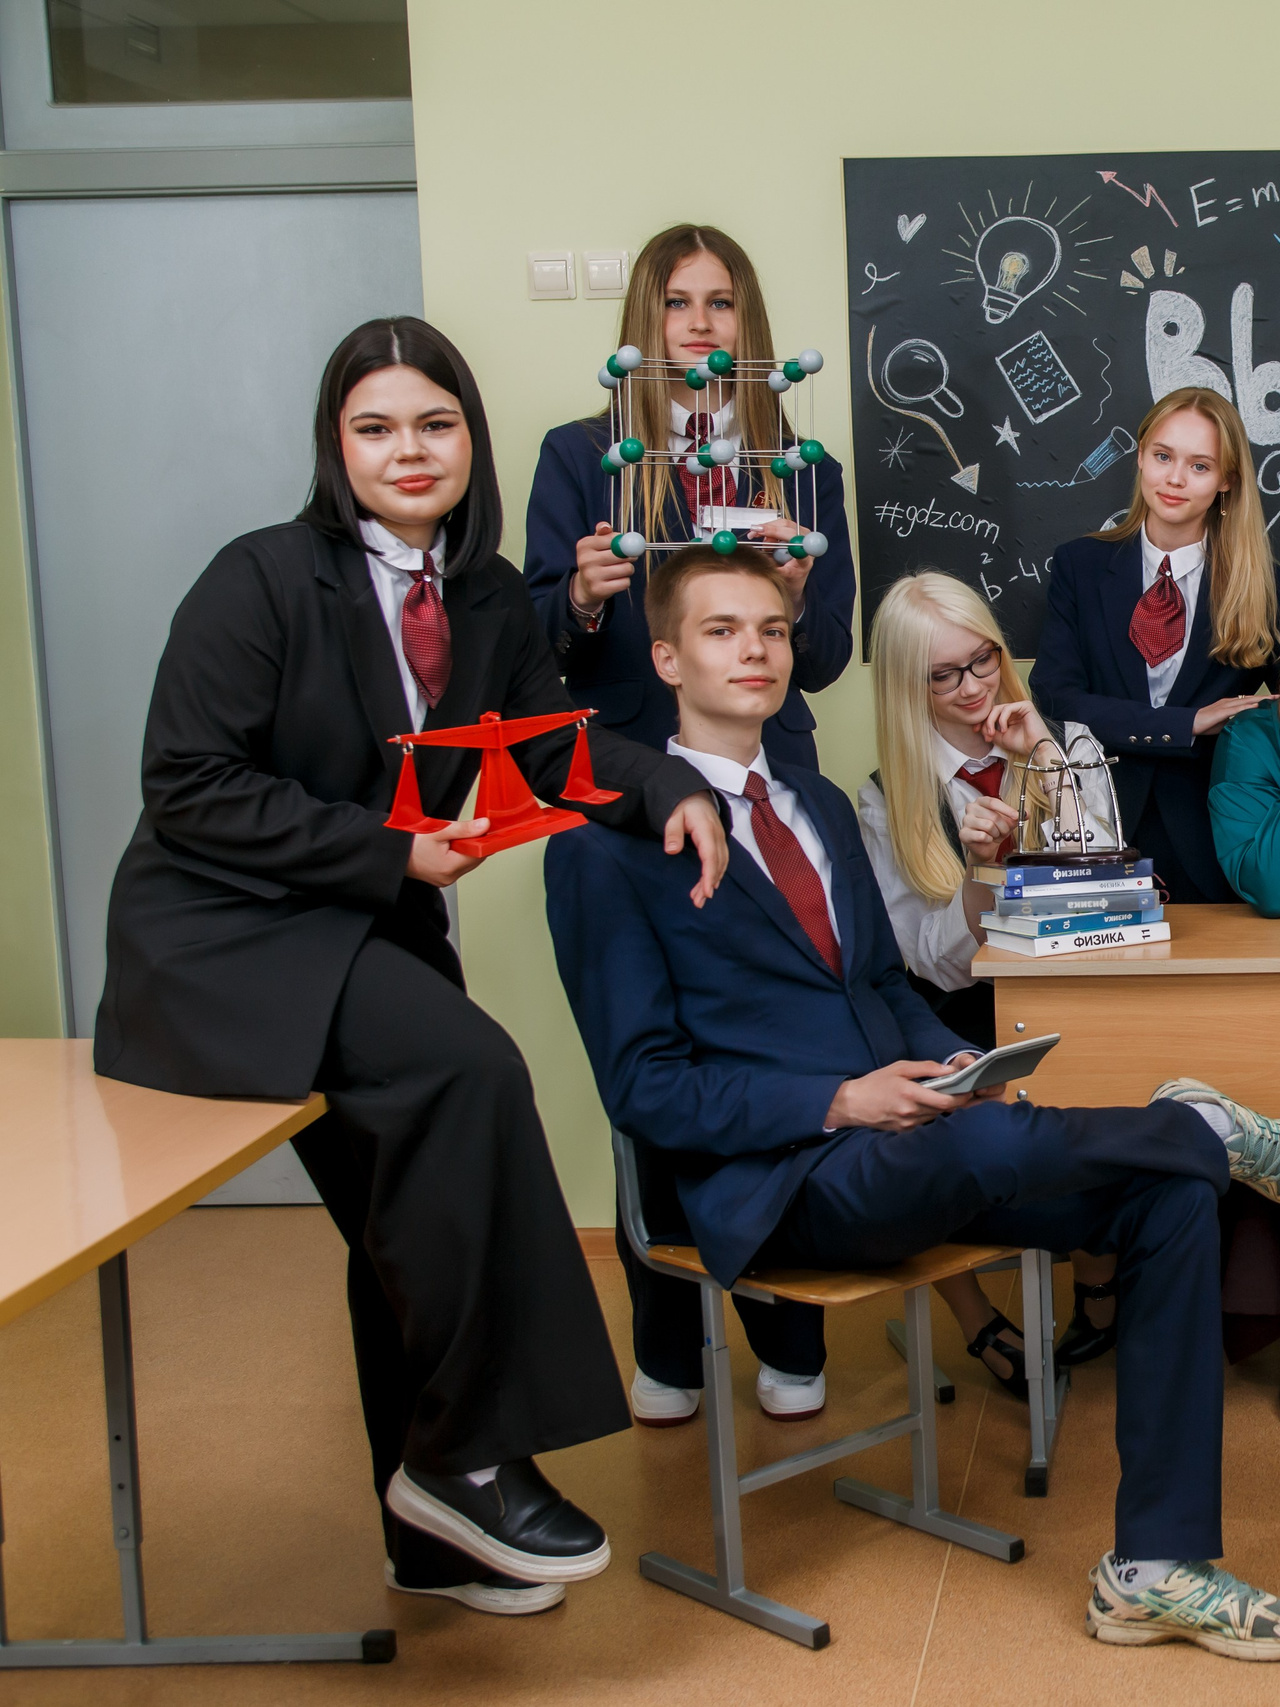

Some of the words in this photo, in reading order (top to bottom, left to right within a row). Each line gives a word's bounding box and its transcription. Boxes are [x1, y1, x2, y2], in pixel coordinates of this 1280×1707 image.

[874, 497, 1000, 544] #gdz.com
[1053, 867, 1092, 881] физика
[1124, 863, 1135, 876] 11
[1098, 881, 1126, 889] ФИЗИКА
[1067, 897, 1109, 910] физика
[1062, 919, 1071, 930] 10
[1103, 913, 1133, 923] ФИЗИКА
[1073, 931, 1126, 948] ФИЗИКА
[1141, 928, 1151, 940] 11
